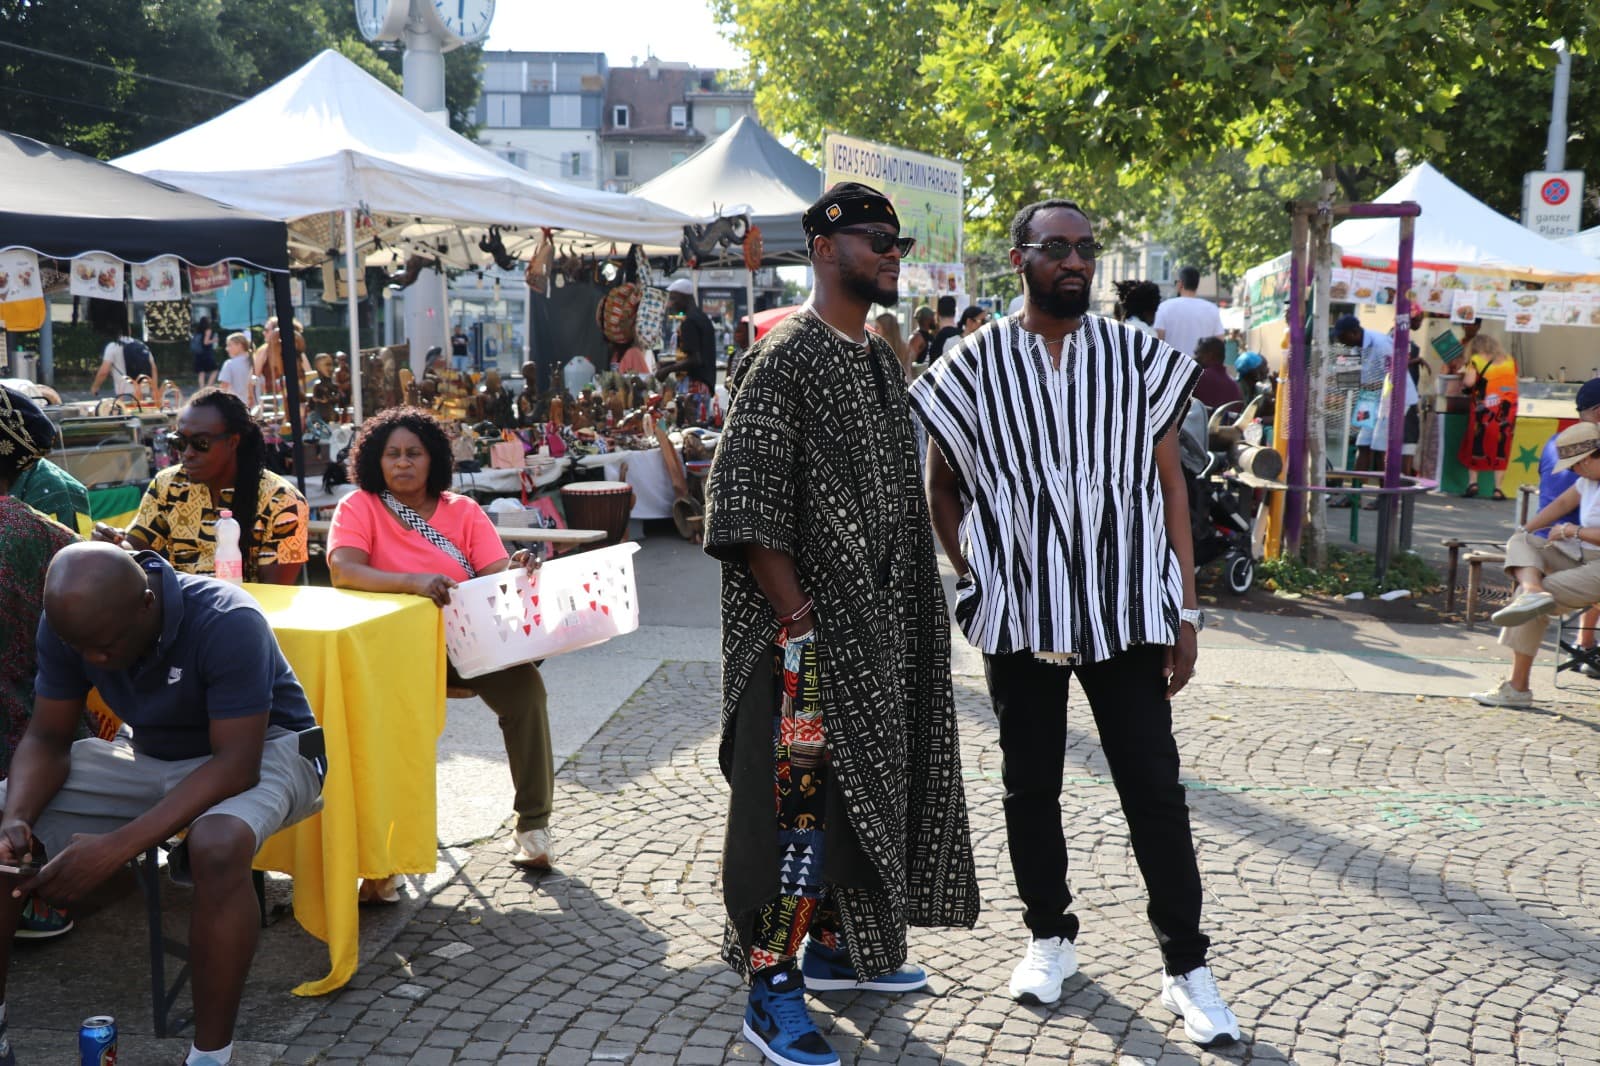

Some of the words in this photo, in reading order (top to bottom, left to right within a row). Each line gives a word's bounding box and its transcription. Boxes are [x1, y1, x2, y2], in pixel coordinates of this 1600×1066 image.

[833, 143, 859, 174] VERA'S
[861, 150, 881, 179] FOOD
[882, 156, 898, 182] AND
[900, 160, 927, 188] VITAMIN
[928, 165, 957, 195] PARADISE
[1536, 214, 1571, 225] ganzer
[1540, 225, 1565, 235] Platz
